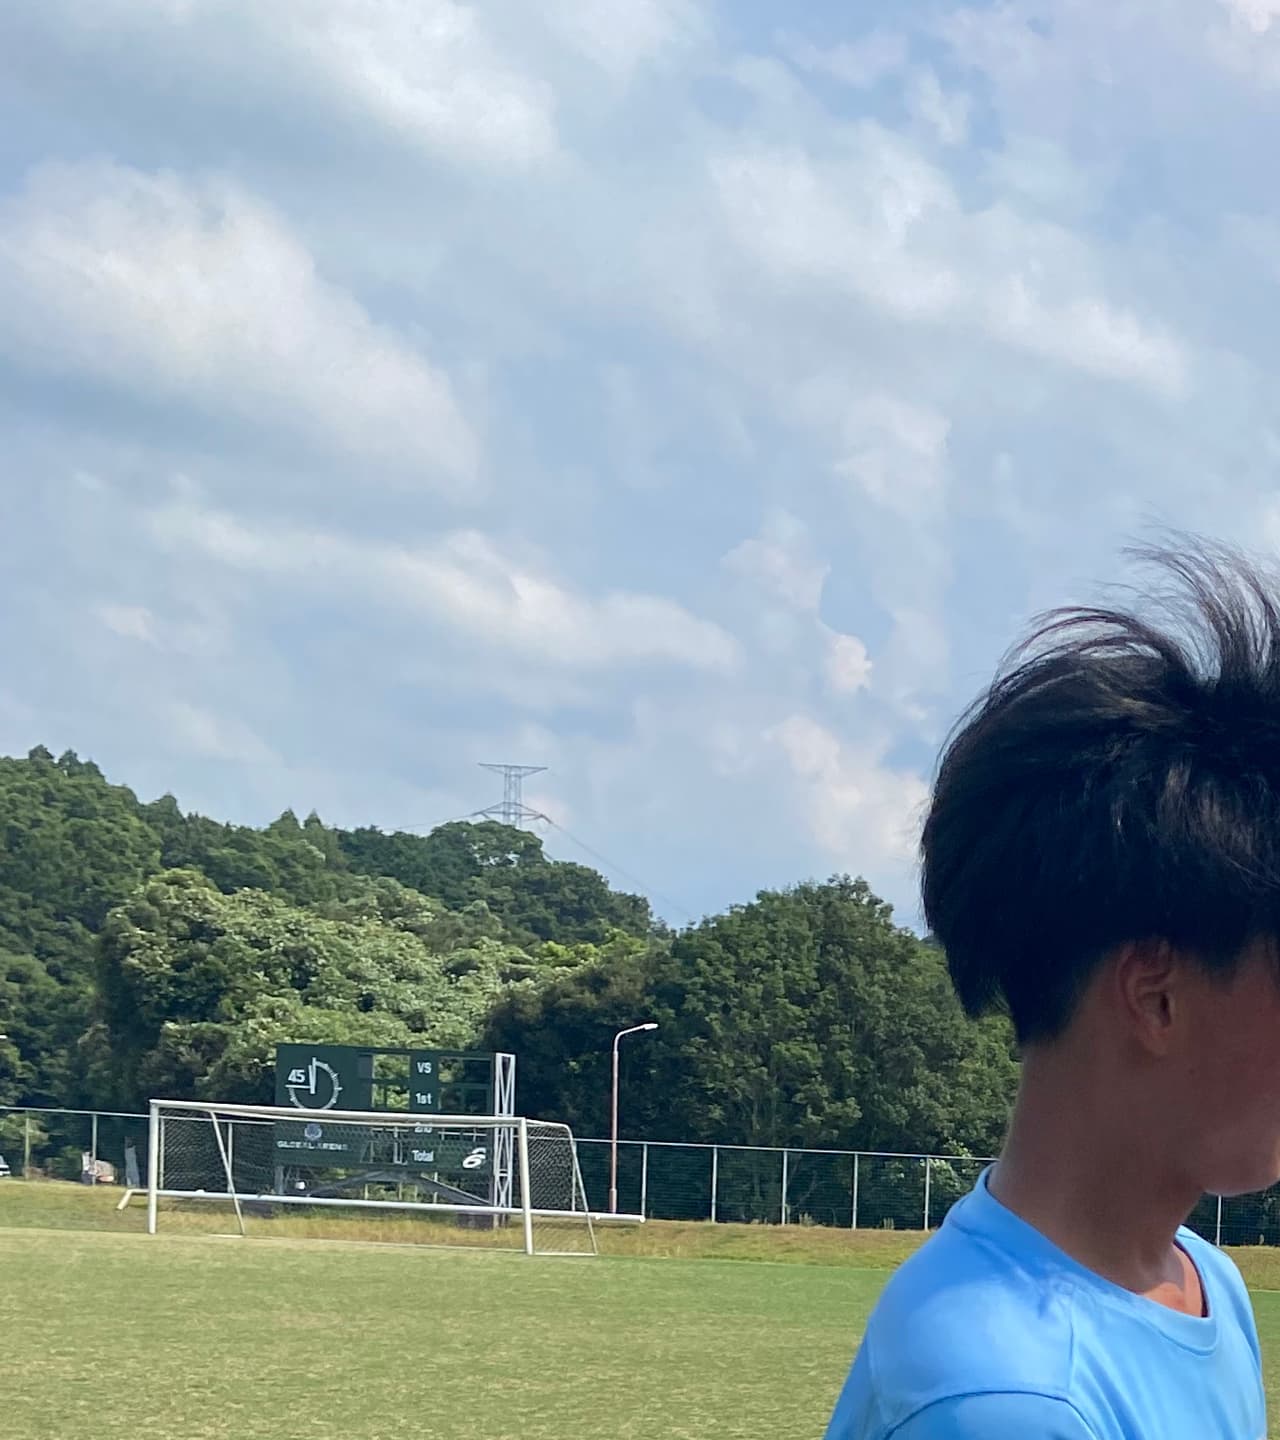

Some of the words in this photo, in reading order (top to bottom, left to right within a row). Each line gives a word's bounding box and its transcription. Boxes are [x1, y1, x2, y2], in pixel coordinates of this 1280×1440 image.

[417, 1062, 432, 1073] VS
[288, 1068, 305, 1083] 45
[416, 1092, 432, 1104] 1st
